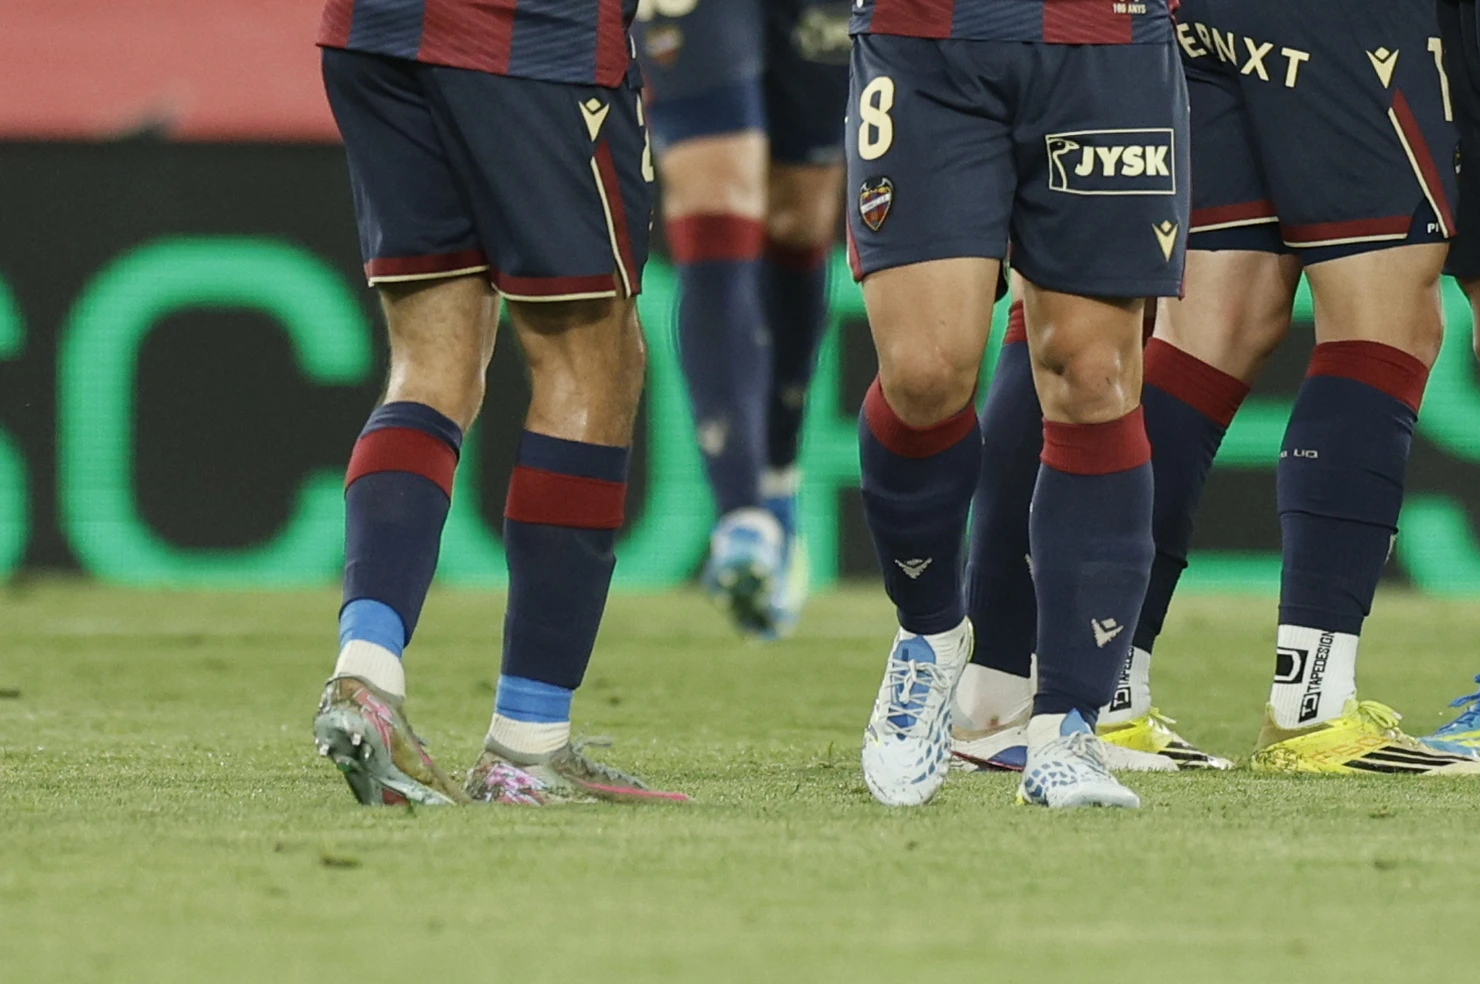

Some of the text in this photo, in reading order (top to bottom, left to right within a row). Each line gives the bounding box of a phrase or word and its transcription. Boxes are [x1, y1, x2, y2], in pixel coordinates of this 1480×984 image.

[1176, 21, 1311, 88] ERNXT
[858, 76, 895, 160] 8
[1074, 145, 1170, 177] JYSK
